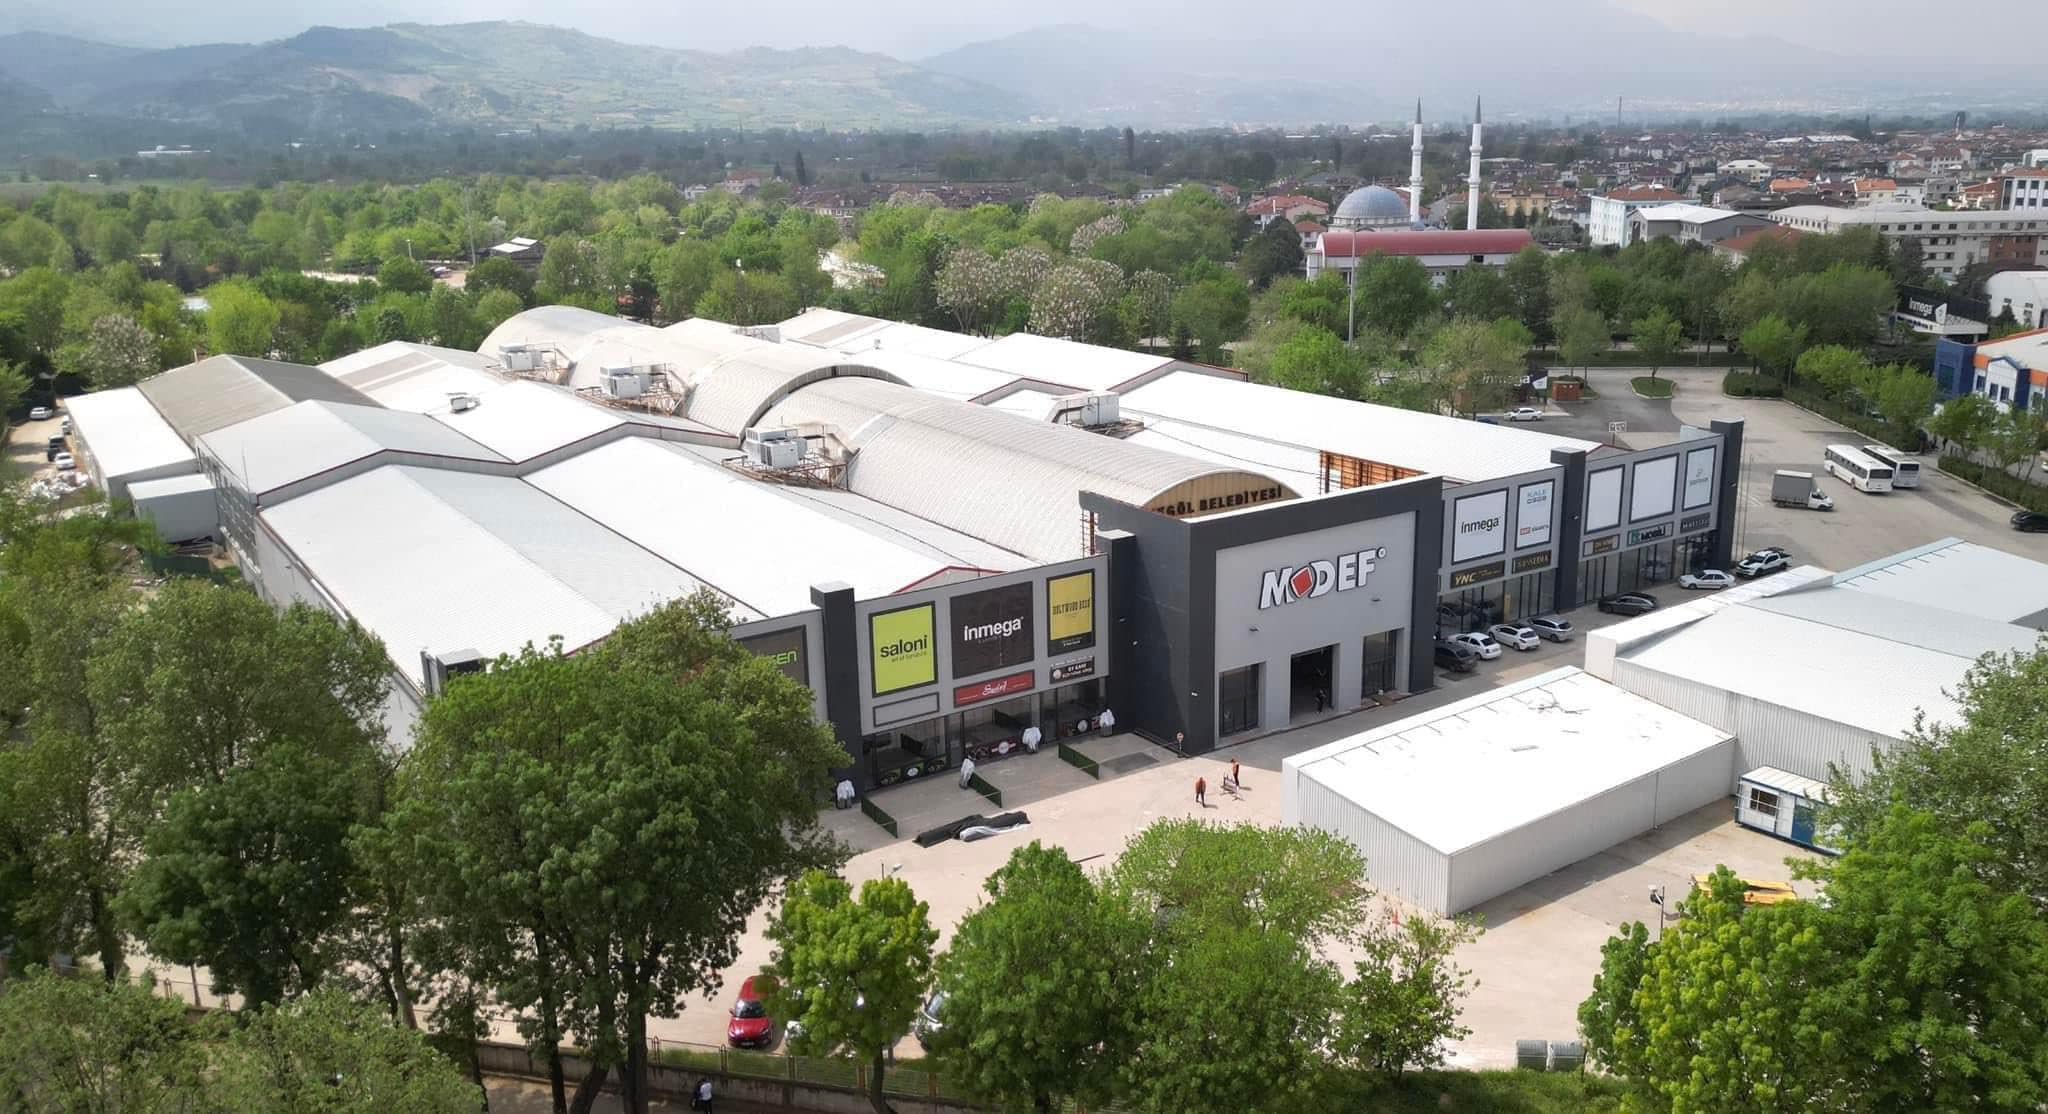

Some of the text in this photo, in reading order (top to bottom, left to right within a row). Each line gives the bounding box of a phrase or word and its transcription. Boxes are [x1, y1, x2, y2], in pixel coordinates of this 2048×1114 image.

[1199, 485, 1282, 511] BELEDİYESİ
[1461, 517, 1499, 534] inmega
[963, 618, 1022, 641] inmega
[880, 634, 928, 658] saloni
